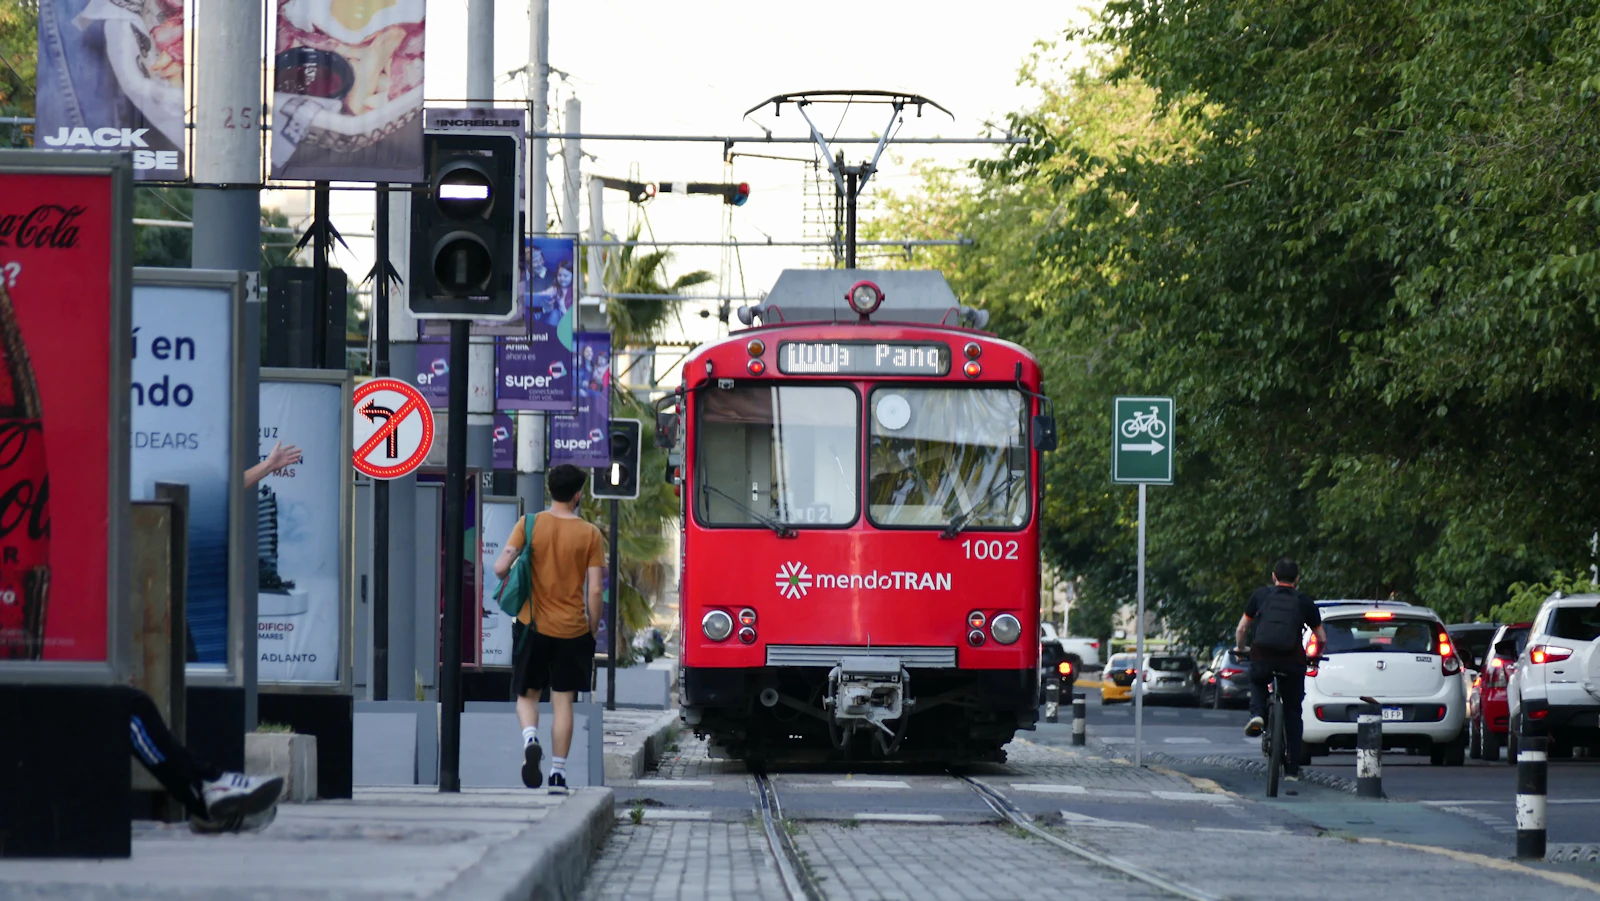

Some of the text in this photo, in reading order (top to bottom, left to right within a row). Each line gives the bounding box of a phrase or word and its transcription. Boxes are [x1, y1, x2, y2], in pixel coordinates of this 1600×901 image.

[43, 127, 149, 147] JACK
[151, 336, 195, 360] en
[505, 375, 552, 391] super
[130, 431, 199, 450] DEARS
[554, 438, 592, 451] super
[273, 465, 296, 478] MÁS
[961, 539, 1019, 560] 1002
[816, 570, 952, 591] mendoTRAN
[261, 653, 317, 663] ADLANTO
